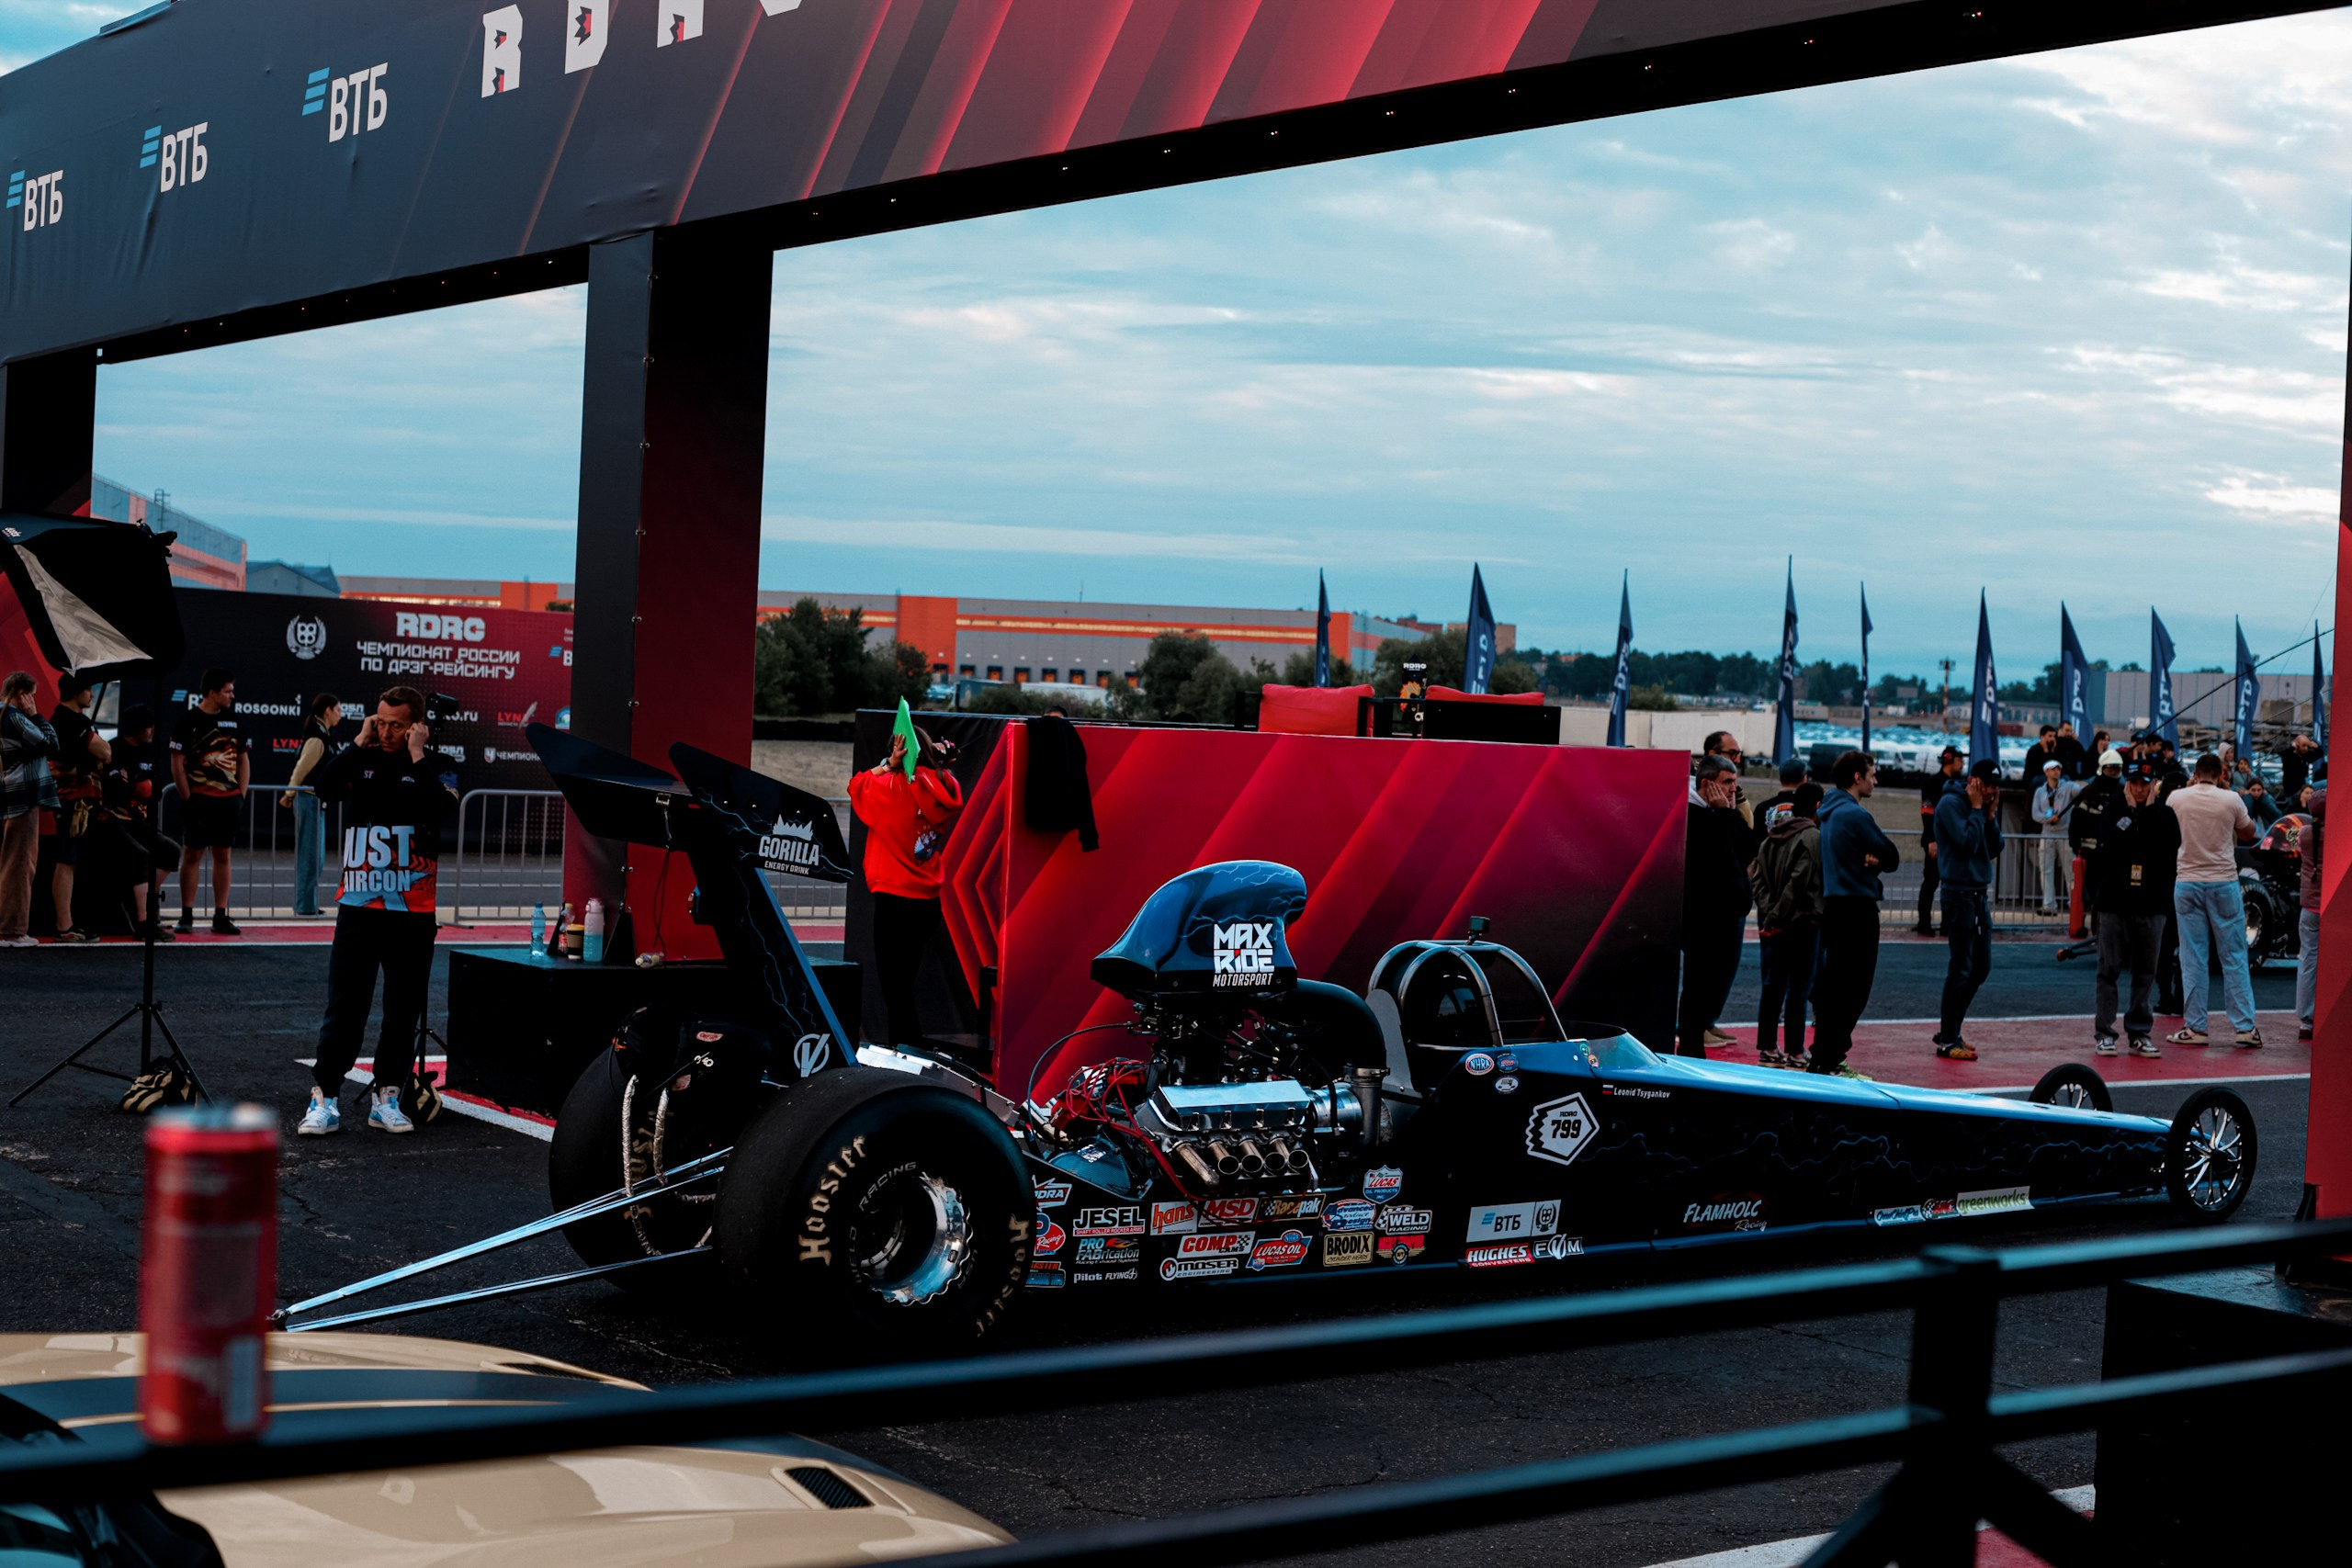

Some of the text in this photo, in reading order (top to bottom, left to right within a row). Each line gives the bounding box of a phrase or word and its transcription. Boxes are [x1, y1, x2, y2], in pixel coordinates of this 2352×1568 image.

[329, 62, 388, 142] ВТБ
[160, 121, 208, 193] ВТБ
[23, 170, 63, 231] ВТБ
[395, 611, 486, 642] RDRC
[356, 640, 521, 664] ЧЕМПИОНАТ РОССИИ
[360, 657, 515, 680] ПО ДРЭГ-РЕЙСИНГУ
[496, 750, 541, 761] ЧЕМПИОН
[759, 836, 820, 866] GORILLA
[764, 860, 810, 875] ENERGY DRINK
[1214, 923, 1272, 949] MAX
[1213, 973, 1273, 987] MOTORSPORT
[1469, 1058, 1490, 1070] NHRA
[1613, 1087, 1670, 1099] Leonid Tsygankov
[1551, 1119, 1582, 1139] 799
[858, 1161, 917, 1212] RACING
[1368, 1178, 1399, 1187] LUCAS
[1206, 1199, 1256, 1218] MSD
[1272, 1198, 1321, 1218] Racepak
[1683, 1199, 1762, 1224] FLAMHOLC
[1958, 1190, 2027, 1214] greenworks
[1074, 1208, 1144, 1228] JESEL
[1153, 1204, 1194, 1234] hans
[1389, 1213, 1430, 1226] WELD
[1494, 1214, 1521, 1233] ВТБ
[1735, 1218, 1768, 1232] Racing
[1079, 1237, 1105, 1250] PRO
[1182, 1235, 1238, 1253] COMP
[1256, 1244, 1302, 1258] LUCAS OIL
[1327, 1235, 1371, 1256] BRODIX
[1076, 1247, 1140, 1261] FABrication
[1467, 1245, 1529, 1262] HUGHES
[1105, 1270, 1129, 1280] FLYING
